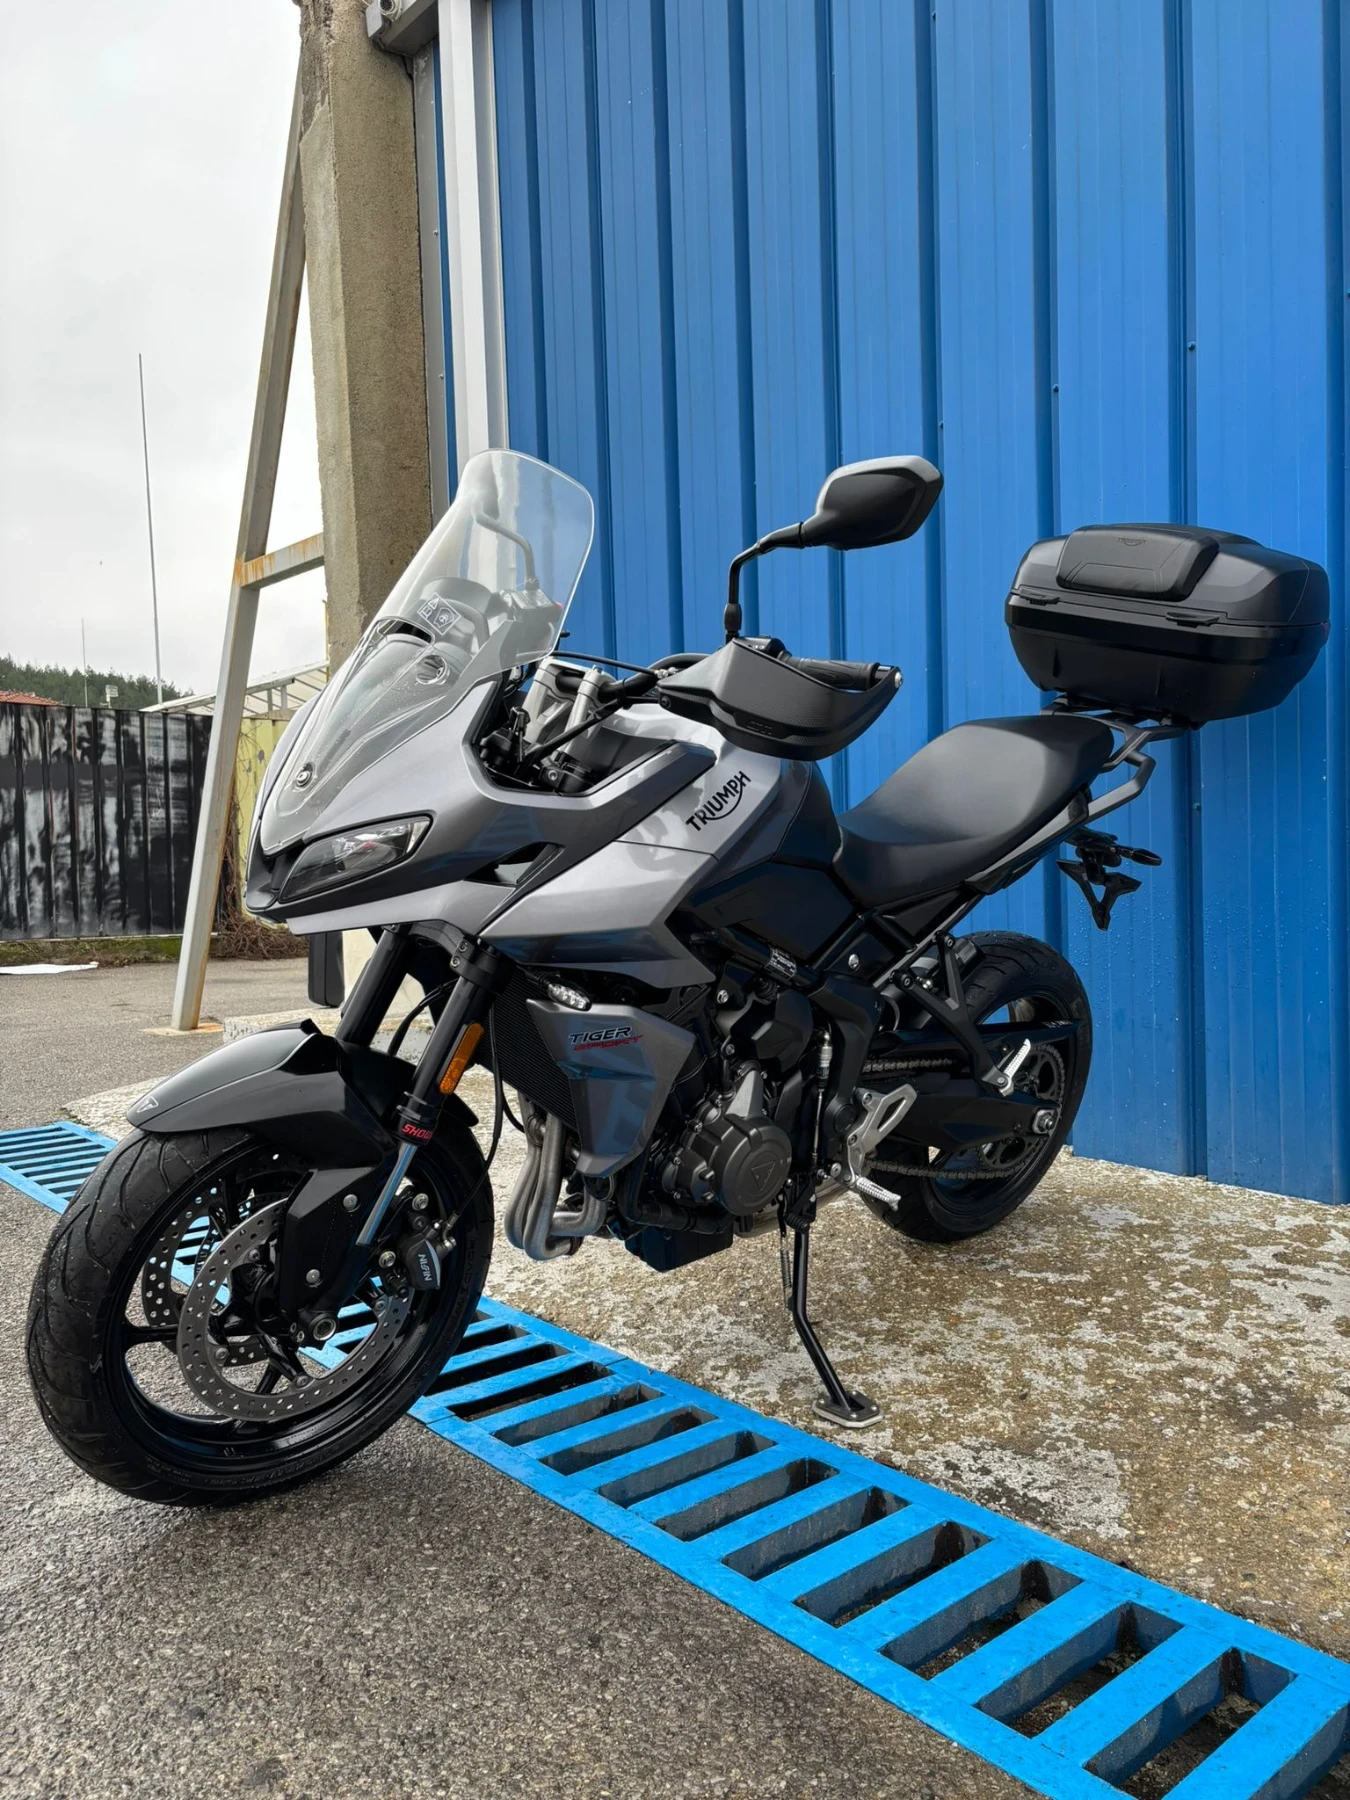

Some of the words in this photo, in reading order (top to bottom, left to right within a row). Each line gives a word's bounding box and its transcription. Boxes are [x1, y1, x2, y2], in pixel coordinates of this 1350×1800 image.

[685, 770, 752, 832] TRIUMPH
[568, 1025, 632, 1045] TIGER
[418, 1253, 432, 1281] NISSIN
